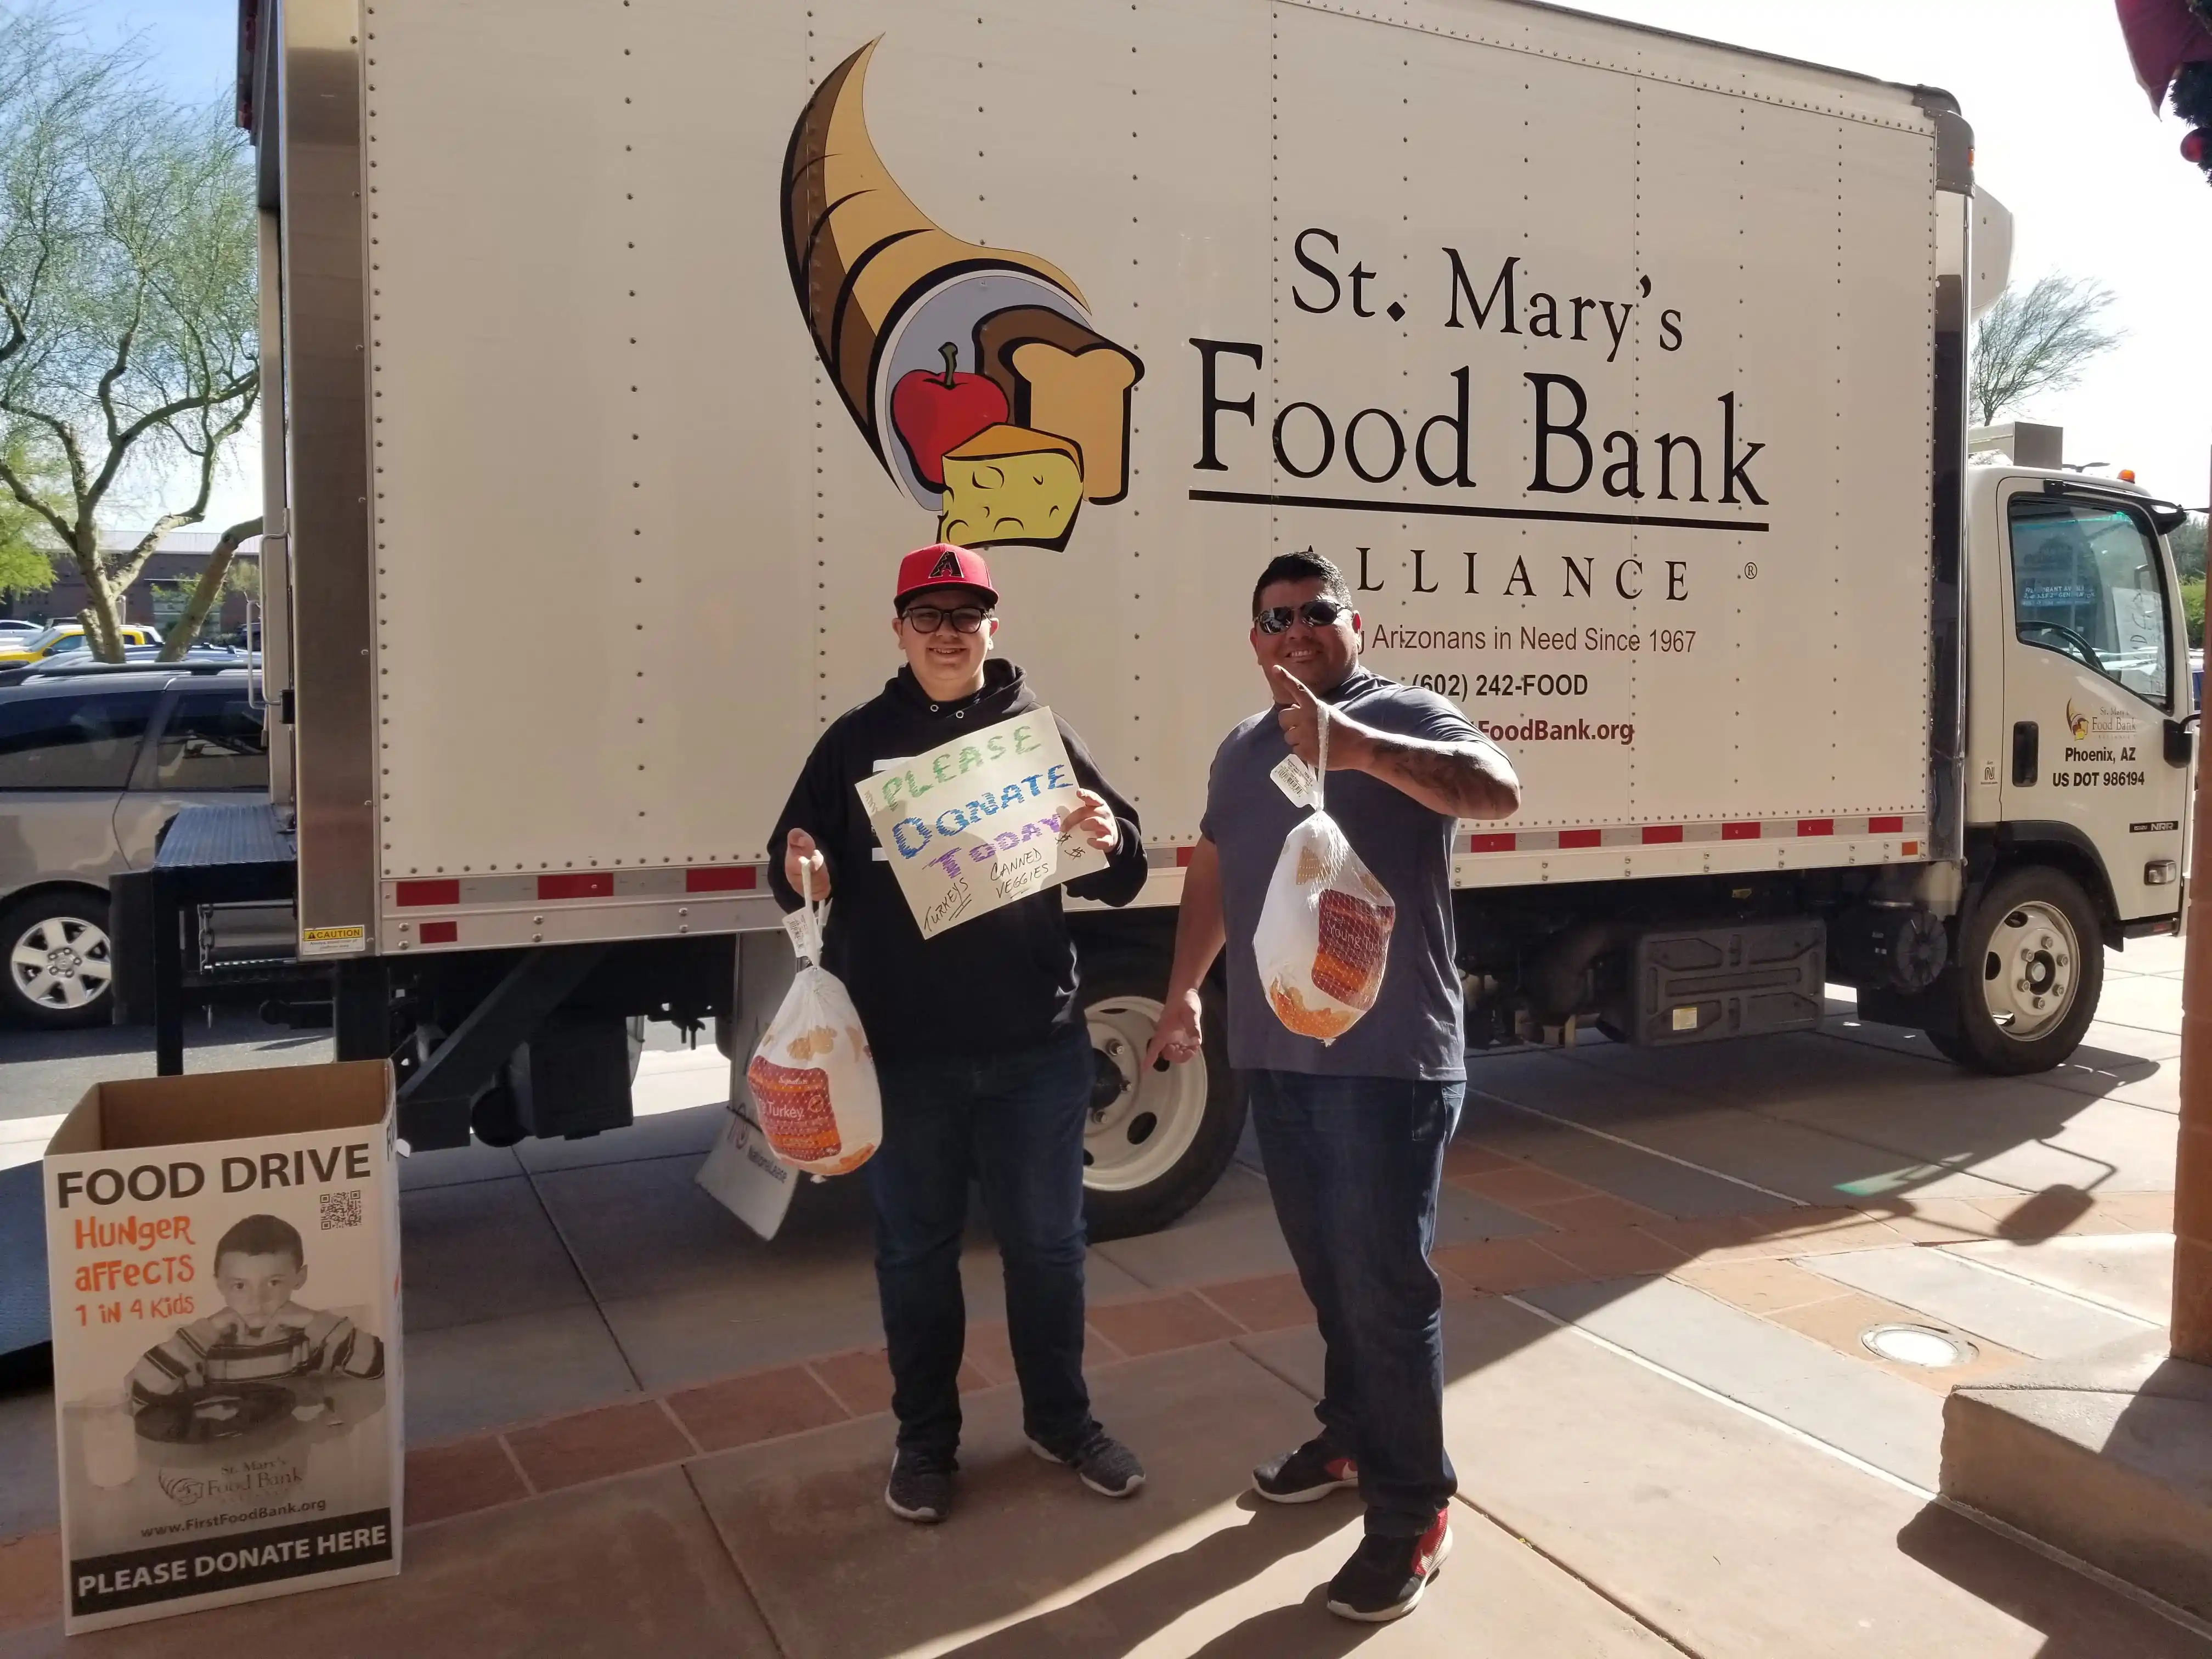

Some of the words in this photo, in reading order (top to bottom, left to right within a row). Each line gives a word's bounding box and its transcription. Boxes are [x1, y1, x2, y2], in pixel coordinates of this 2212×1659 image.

[1292, 228, 1406, 321] St.
[1442, 247, 1682, 362] Mary's
[1188, 337, 1476, 487] Food
[1523, 372, 1769, 505] Bank
[1308, 545, 1688, 601] LLIANCE
[1372, 624, 1486, 650] Arizonans
[1494, 627, 1511, 650] in
[1521, 627, 1577, 651] Need
[1585, 629, 1640, 652] Since
[1649, 631, 1696, 653] 1967
[1413, 674, 1468, 702] (602)
[1476, 674, 1588, 697] 242-FOOD
[1471, 719, 1633, 745] FoodBank.org
[2092, 717, 2112, 730] Food
[2116, 717, 2136, 731] Bank
[882, 726, 1041, 811] PLEASE
[2065, 747, 2115, 764] Phoenix,
[2120, 747, 2136, 761] AZ
[2053, 772, 2069, 787] US
[2074, 771, 2100, 787] DOT
[2103, 771, 2145, 786] 986194
[892, 764, 1073, 859] DONATE
[2151, 822, 2173, 831] NRR
[922, 814, 1062, 878] TODAY
[990, 847, 1042, 881] CANNED
[996, 863, 1049, 898] VEGGIES
[924, 878, 969, 932] TURKEYS
[317, 929, 360, 939] CAUTION
[57, 1161, 205, 1209] FOOD
[221, 1143, 371, 1193] DRIVE
[75, 1304, 87, 1327] 1
[130, 1297, 143, 1320] 4
[258, 1466, 303, 1488] Bank
[140, 1498, 326, 1538] www.FirstFoodBank.org
[78, 1560, 187, 1598] PLEASE
[195, 1539, 311, 1578] DONATE
[317, 1526, 386, 1558] HERE
